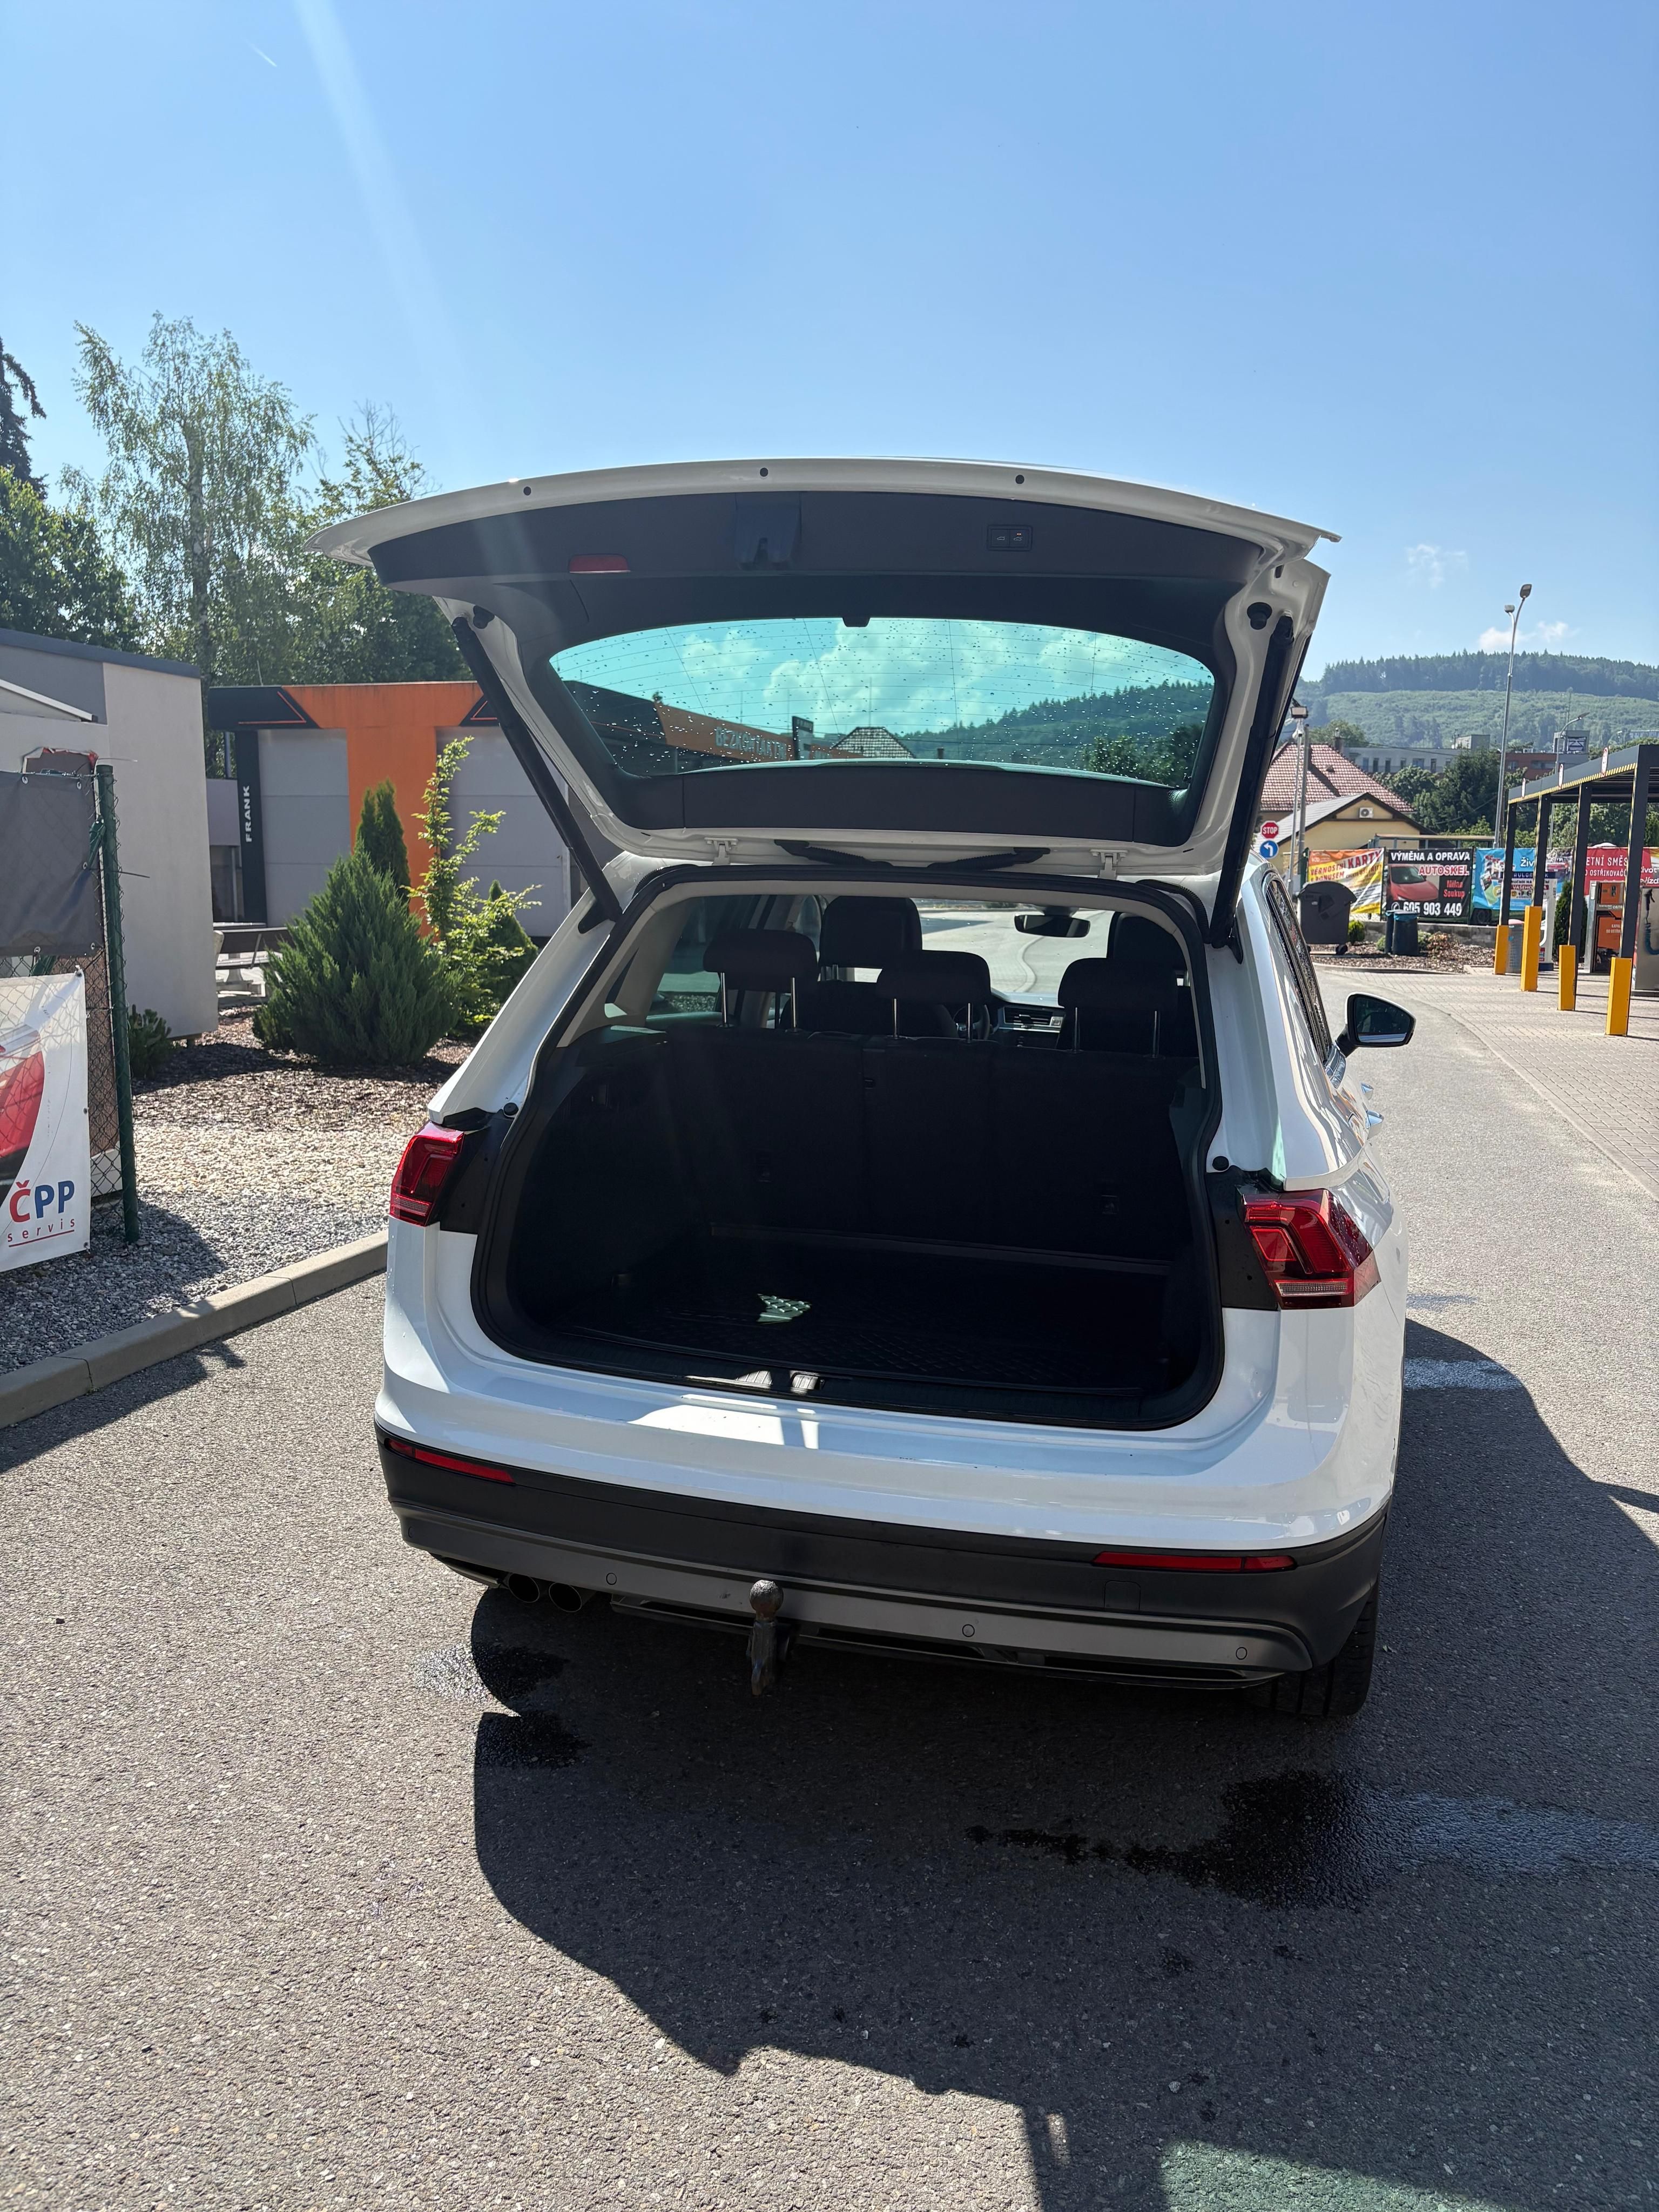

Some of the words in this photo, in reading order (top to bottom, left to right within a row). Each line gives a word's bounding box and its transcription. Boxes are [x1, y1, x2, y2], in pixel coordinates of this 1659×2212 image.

[243, 785, 252, 842] FRANK
[1391, 851, 1425, 861] VÝMĚNA
[1427, 852, 1433, 861] A
[1435, 852, 1470, 861] OPRAVA
[1586, 855, 1604, 866] ETNÍ
[1607, 855, 1628, 866] SMĚS
[1520, 857, 1534, 867] Živ
[1418, 865, 1469, 876] AUTOSKEL
[1444, 889, 1465, 899] Soukup
[1424, 902, 1440, 915] 903
[1444, 902, 1462, 916] 449
[9, 1180, 75, 1223] ČPP
[8, 1218, 75, 1242] servis
